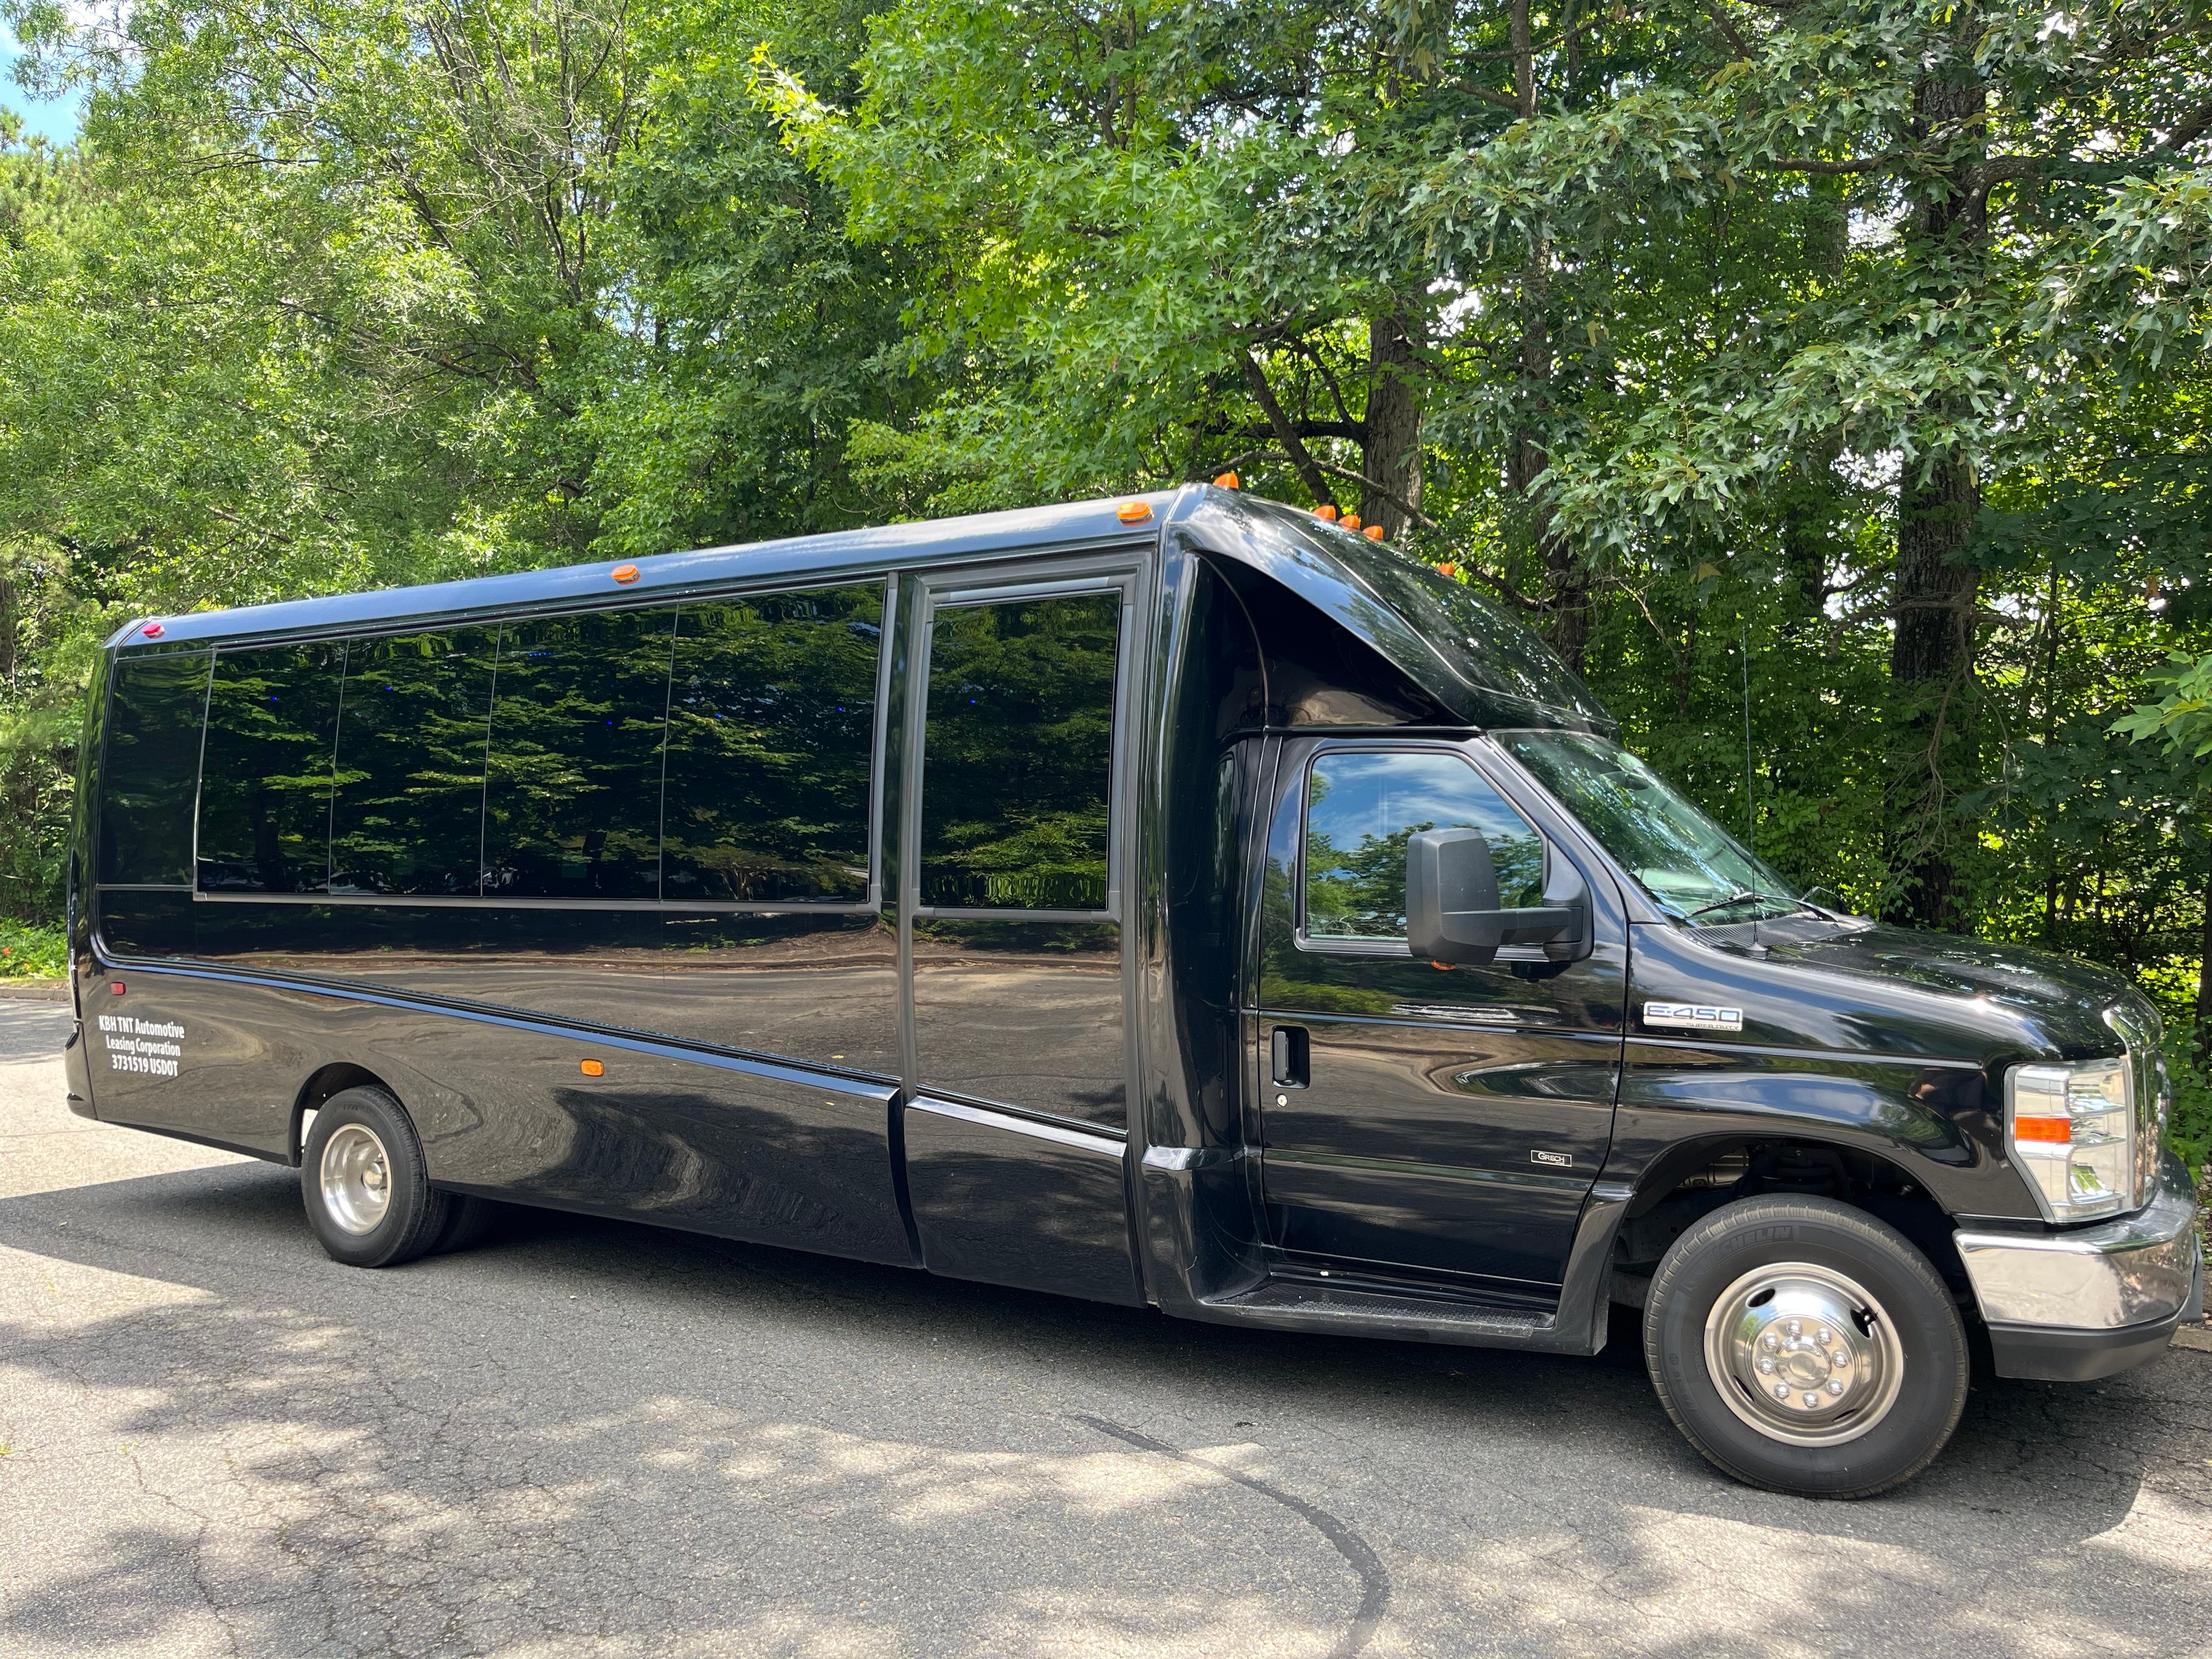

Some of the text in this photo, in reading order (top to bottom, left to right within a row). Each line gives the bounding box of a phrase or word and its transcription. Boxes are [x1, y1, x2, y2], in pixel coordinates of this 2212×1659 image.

[1647, 1005, 1740, 1022] E-450
[99, 1015, 185, 1039] KBH TNT Automotive
[106, 1035, 181, 1056] Leasing Corporation
[112, 1054, 179, 1077] 3731519 USDOT
[1694, 1225, 1792, 1274] MICHELIN
